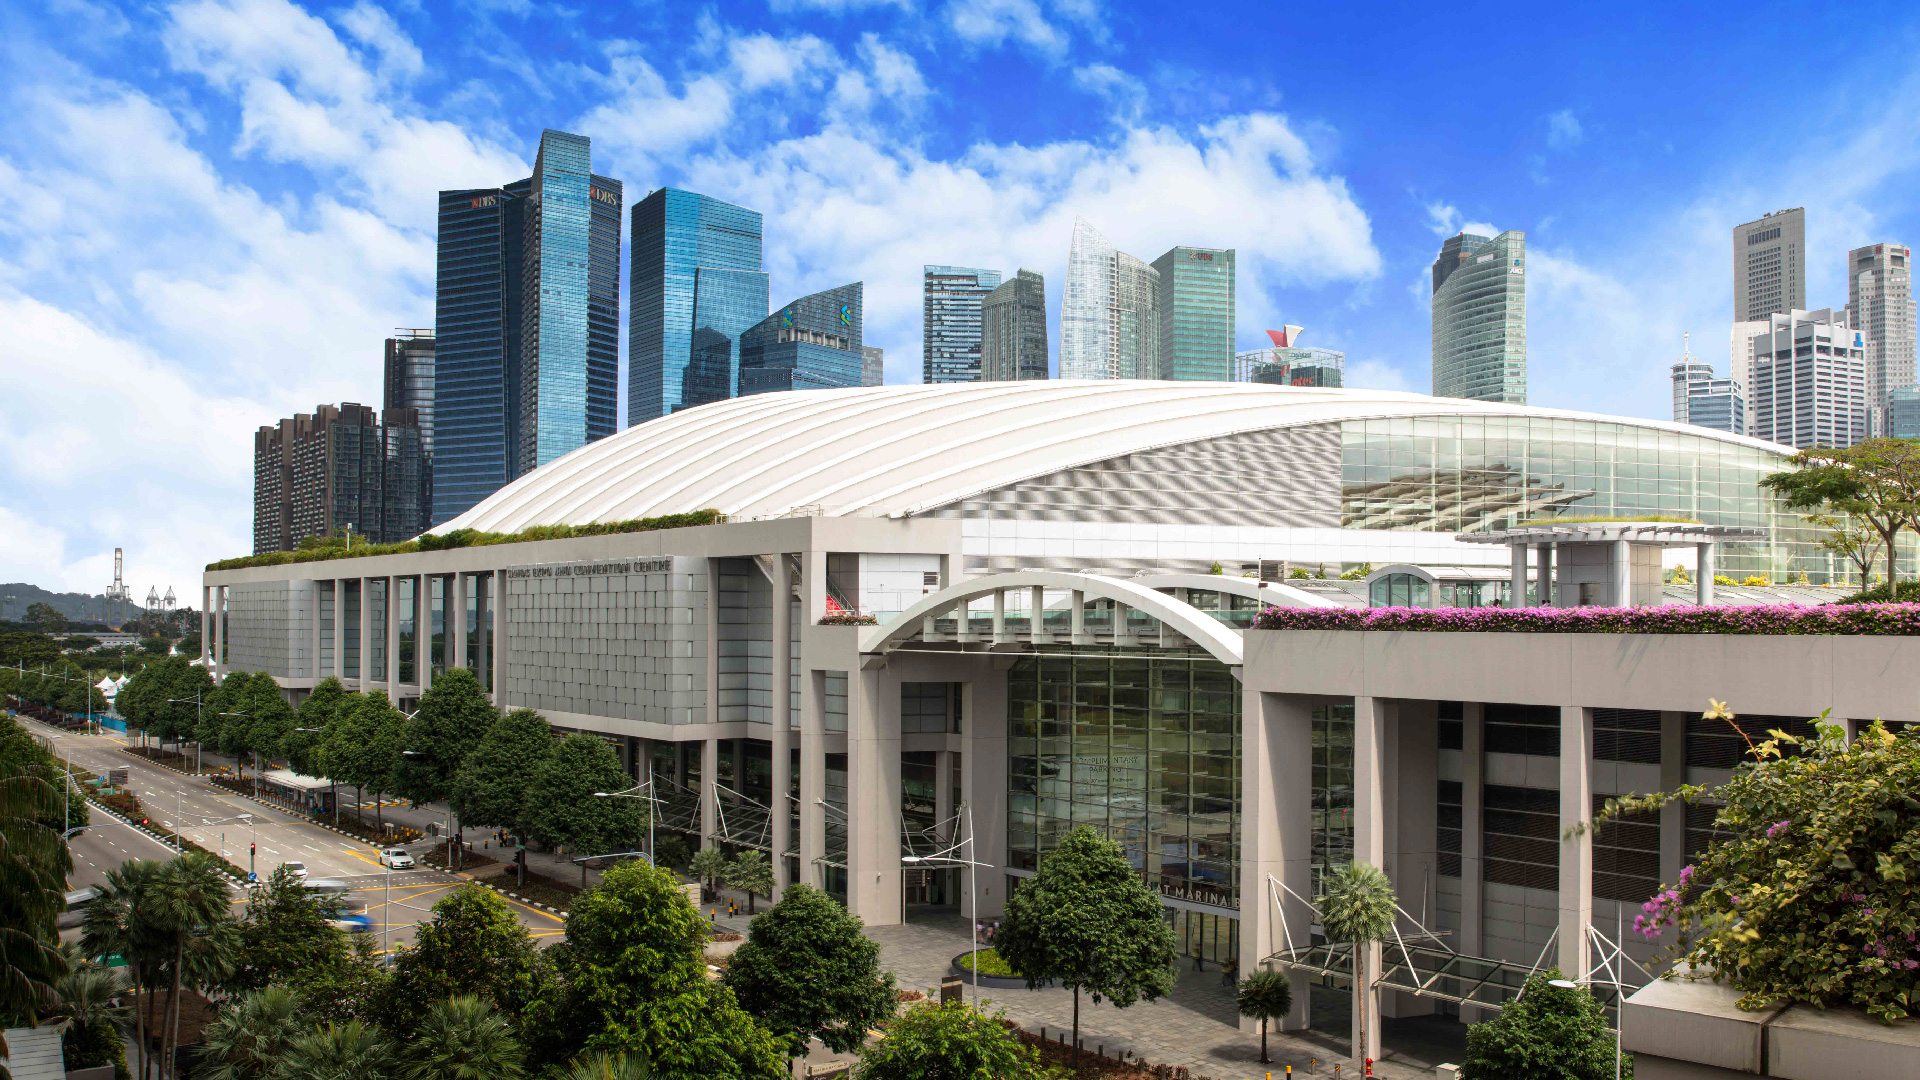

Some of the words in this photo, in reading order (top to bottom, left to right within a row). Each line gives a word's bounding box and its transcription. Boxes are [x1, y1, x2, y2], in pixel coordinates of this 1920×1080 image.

[478, 194, 497, 208] DBS
[596, 188, 617, 206] DBS
[507, 568, 531, 579] SANDS
[532, 566, 553, 578] EXPO
[555, 565, 572, 577] AND
[573, 562, 630, 576] CONVENTION
[633, 559, 672, 573] CENTRE
[1477, 588, 1513, 596] SHOPPE
[1157, 883, 1170, 895] AT
[1175, 886, 1228, 908] MARINA
